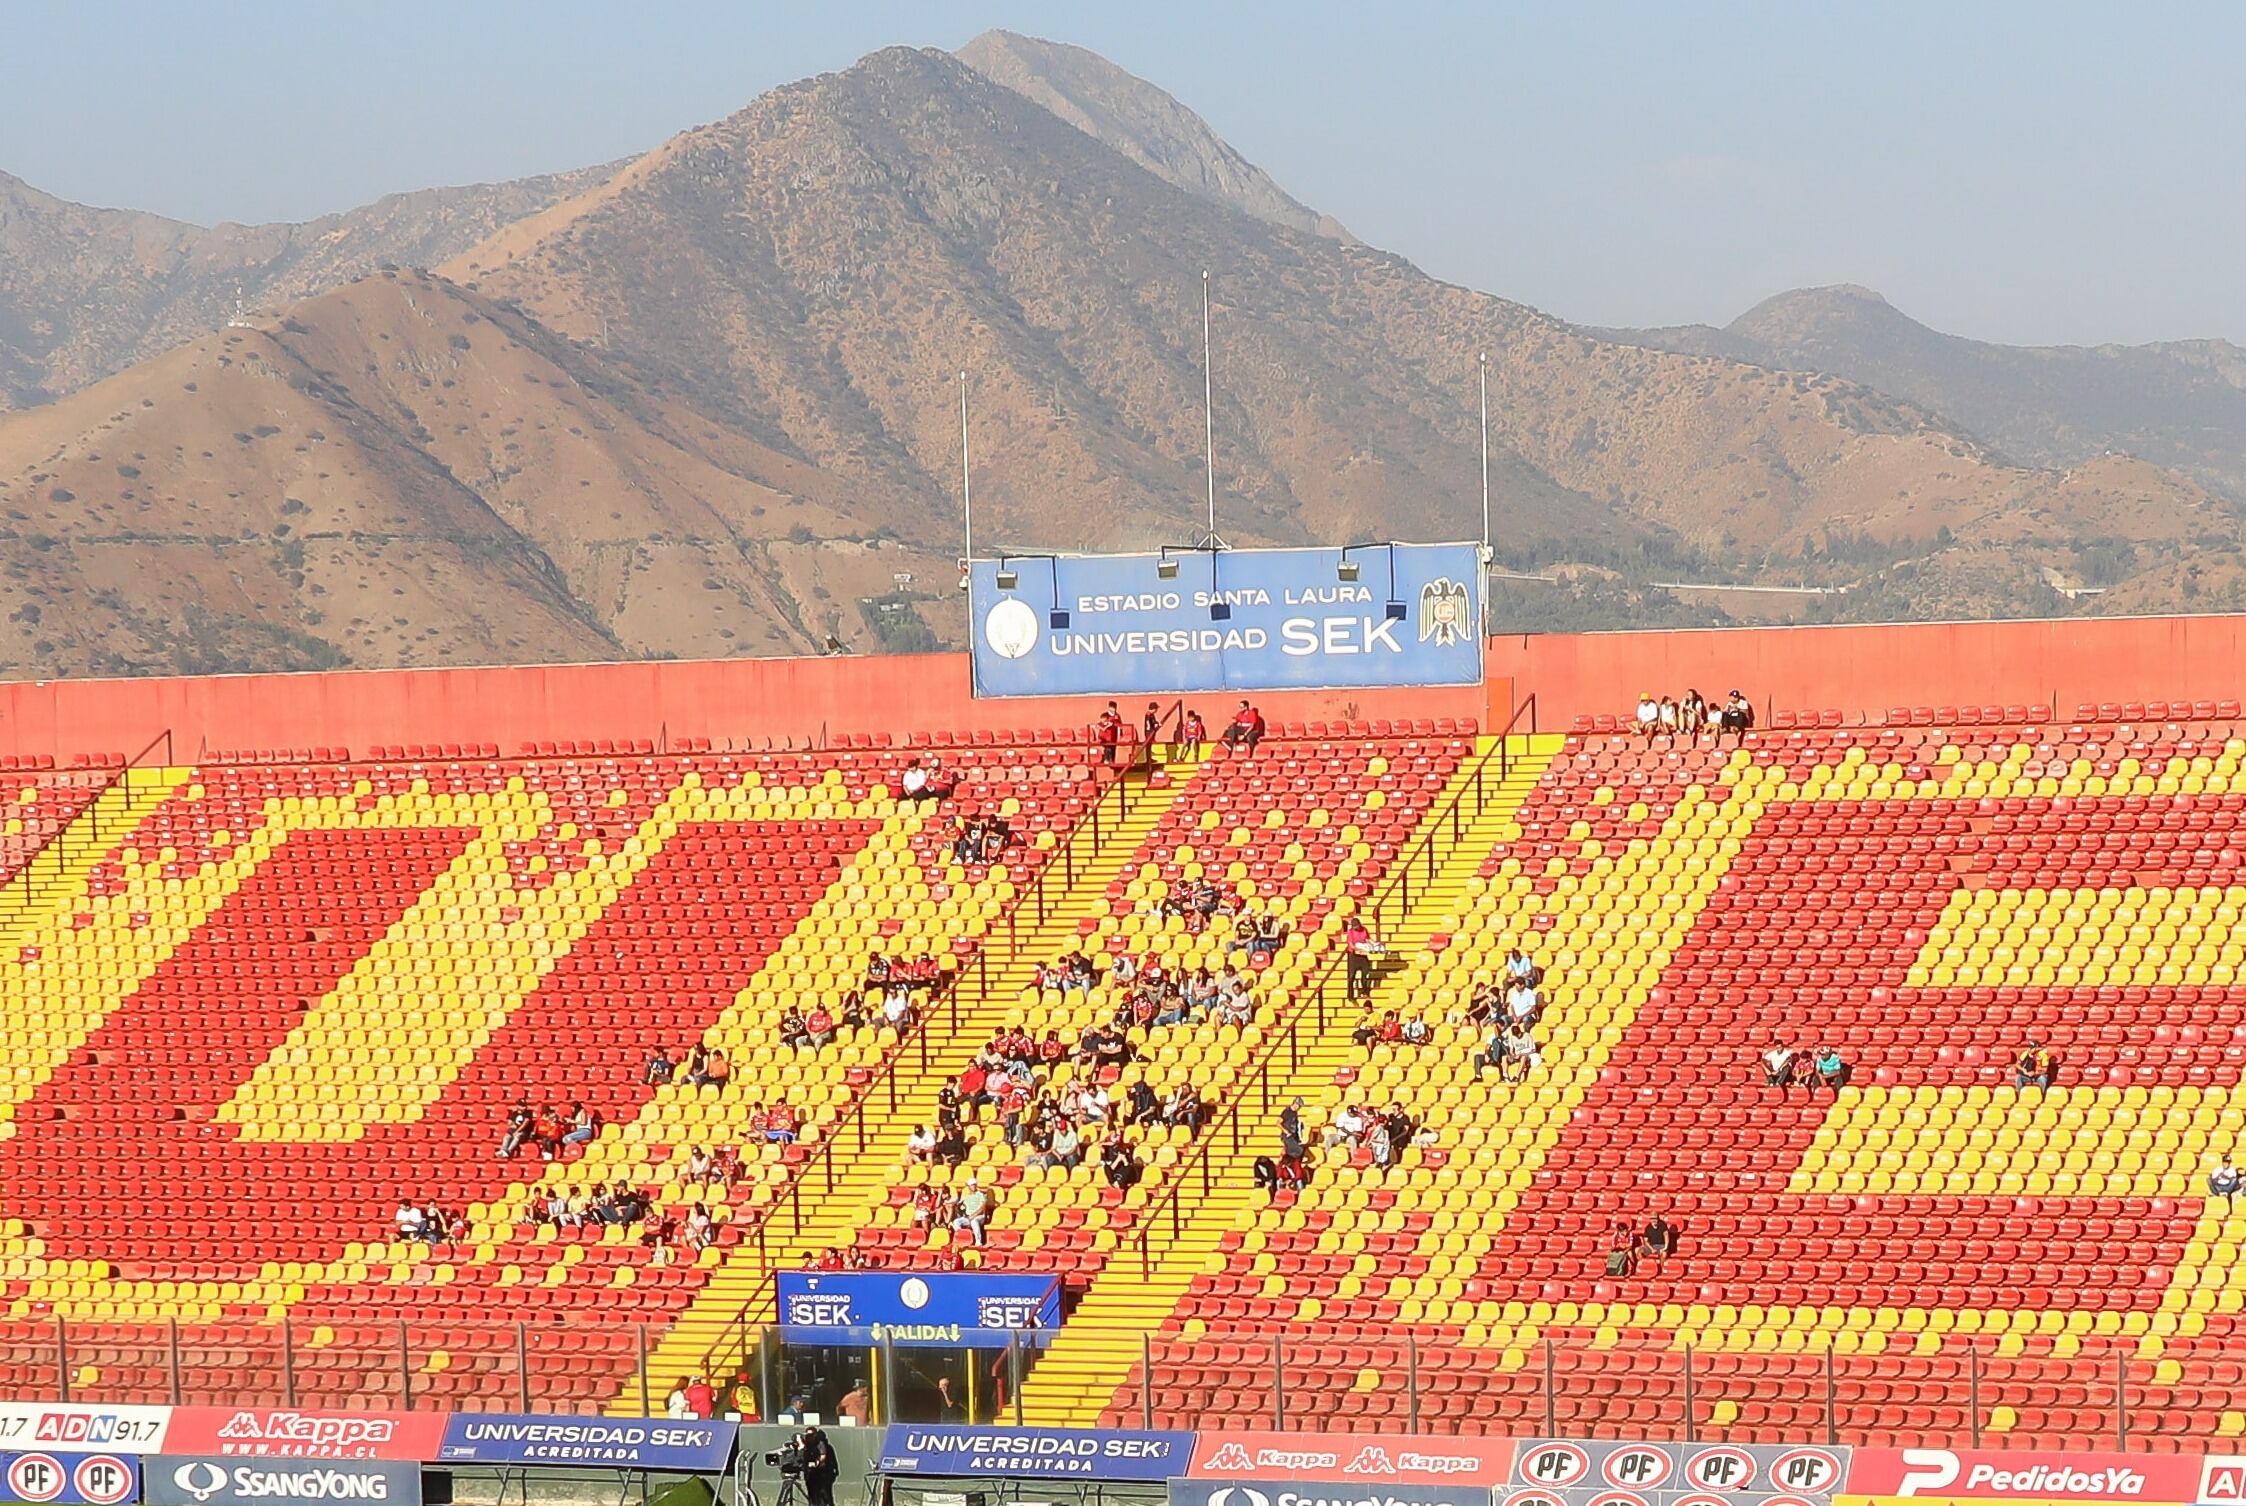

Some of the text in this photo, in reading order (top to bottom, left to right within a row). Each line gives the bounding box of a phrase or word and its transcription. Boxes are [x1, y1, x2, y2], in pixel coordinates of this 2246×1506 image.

[1078, 587, 1373, 613] ESTADIO SANTA LAURA
[1050, 616, 1403, 656] UNIVERSIDAD SEK
[796, 1294, 851, 1303] UNIVERSIDAD
[796, 1304, 852, 1326] SEK
[986, 1306, 1043, 1328] SEK
[36, 1414, 116, 1442] ADN
[115, 1421, 160, 1442] 91.7
[265, 1412, 393, 1445] Kappa
[465, 1423, 704, 1447] UNIVERSIDAD SEK
[221, 1443, 377, 1458] WWW.KAPPA.CL
[524, 1445, 639, 1460] ACREDITADA
[907, 1434, 1163, 1458] UNIVERSIDAD SEK
[1257, 1447, 1337, 1470] Kappa
[970, 1457, 1093, 1472] ACREDITADA
[1397, 1452, 1480, 1473] Kappa
[1536, 1452, 1572, 1480] PF
[1620, 1453, 1655, 1482] PF
[1703, 1456, 1739, 1484] PF
[1787, 1458, 1824, 1486] PF
[24, 1464, 49, 1491] PF
[90, 1466, 116, 1493] PF
[1967, 1465, 2146, 1494] PedidosYa
